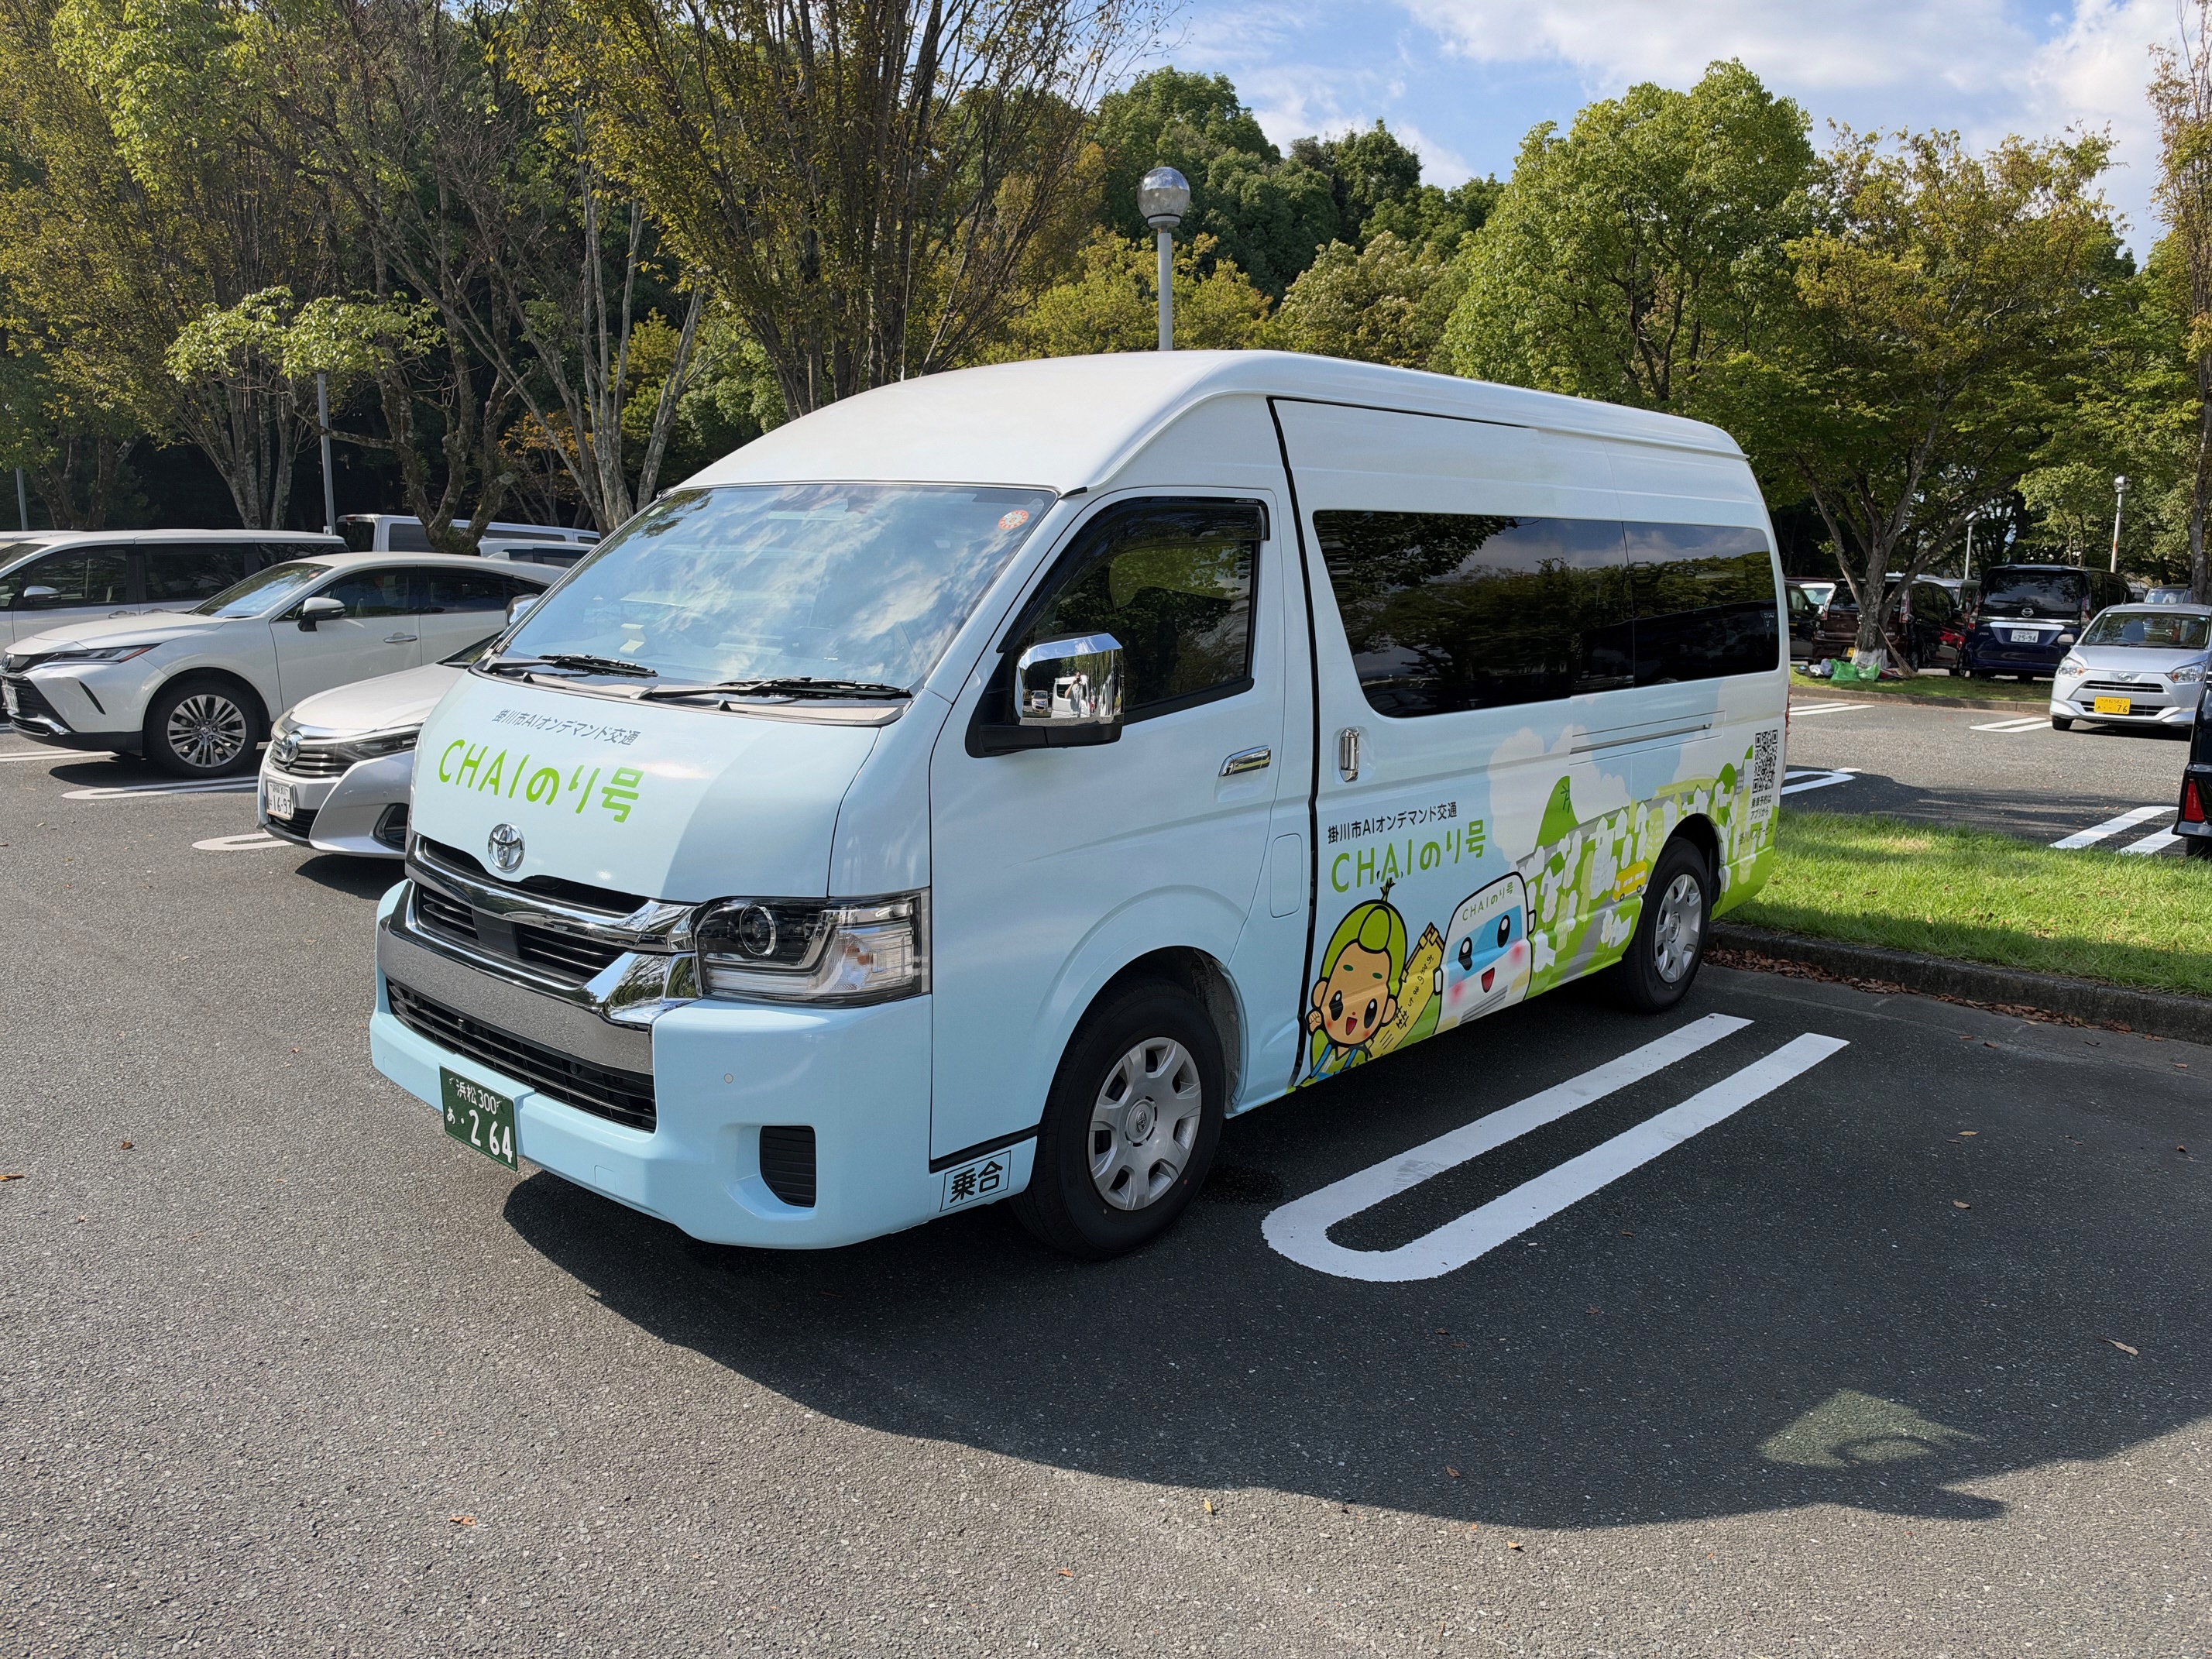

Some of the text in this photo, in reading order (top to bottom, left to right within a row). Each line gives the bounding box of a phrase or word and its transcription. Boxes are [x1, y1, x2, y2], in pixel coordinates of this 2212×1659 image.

[491, 709, 641, 746] 掛川市AIオンデマンド交通
[438, 739, 644, 823] CHAIのり号
[1328, 802, 1458, 844] 掛川市AIオンデマンド交通
[1750, 806, 1769, 821] アプリから
[1331, 819, 1486, 893] CHAIのり号
[1462, 881, 1513, 921] CHAIのり号
[950, 1161, 1003, 1203] 乗合
